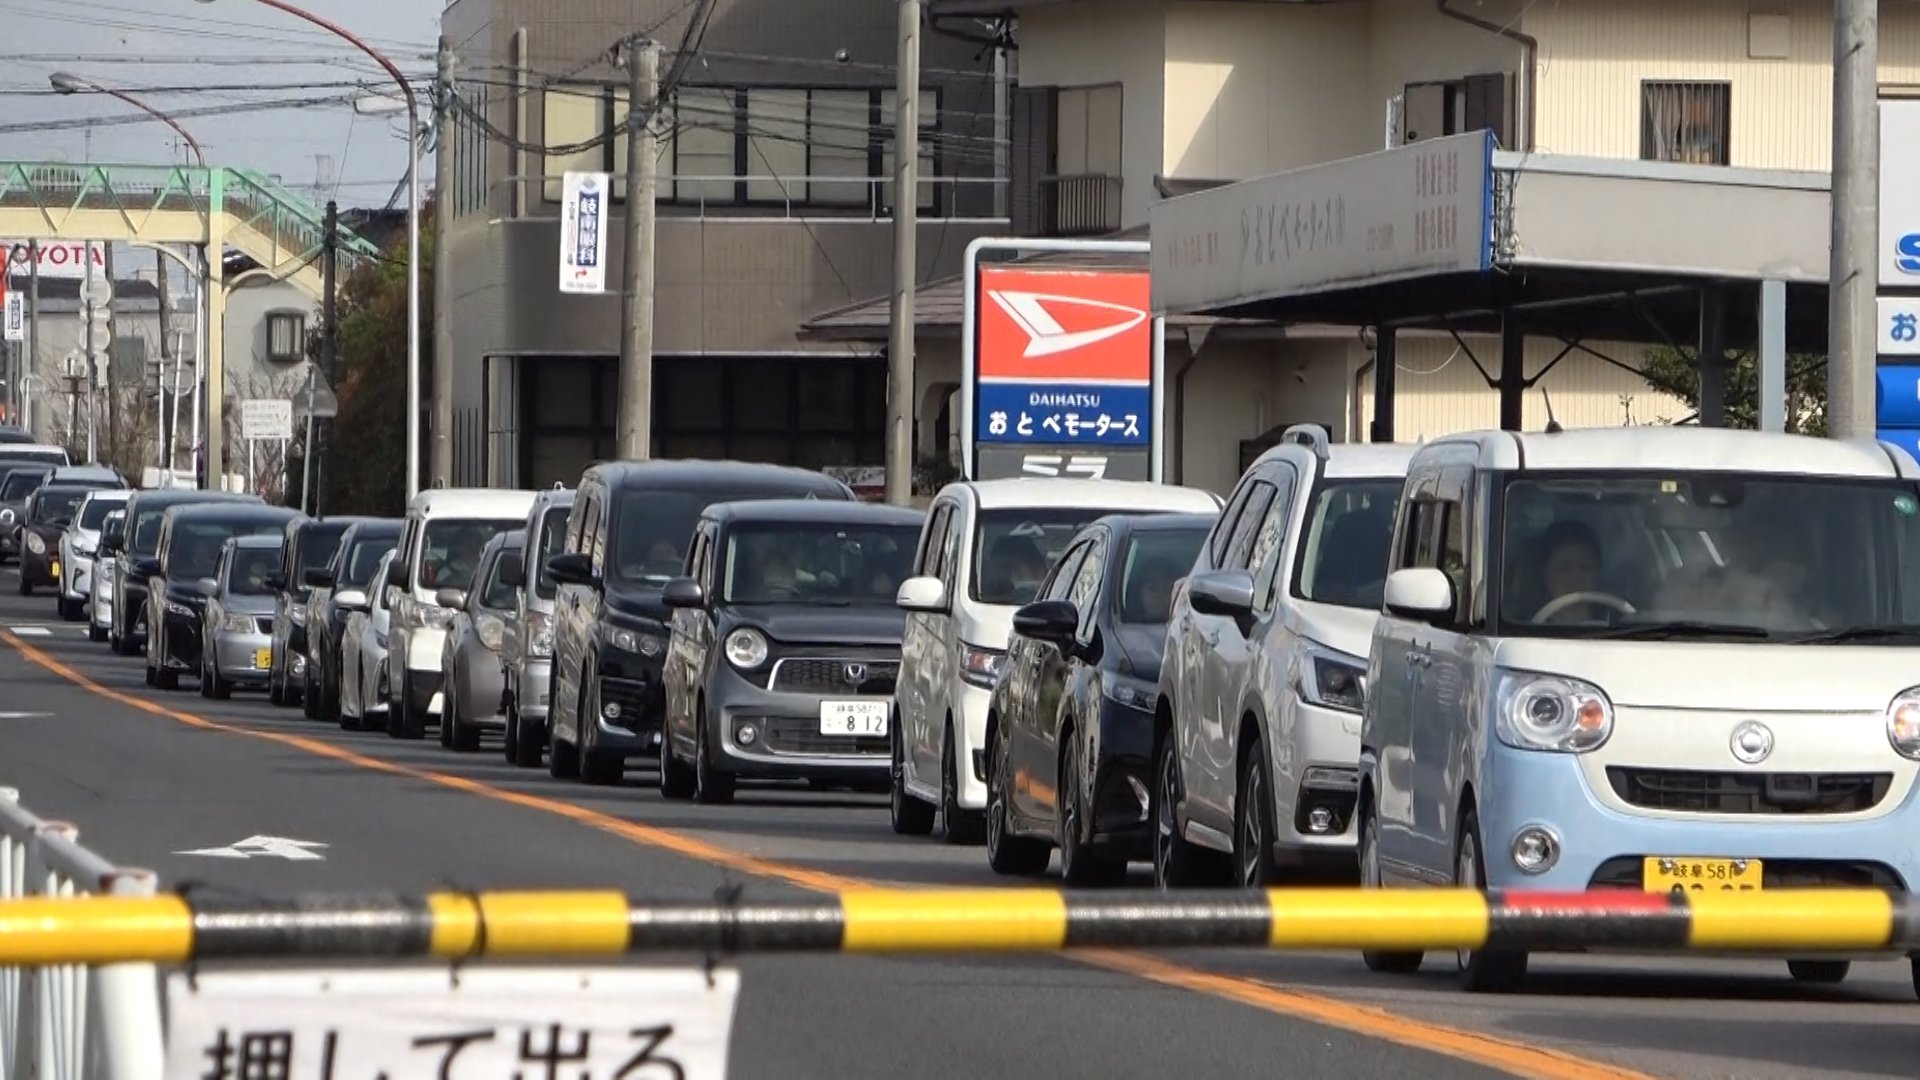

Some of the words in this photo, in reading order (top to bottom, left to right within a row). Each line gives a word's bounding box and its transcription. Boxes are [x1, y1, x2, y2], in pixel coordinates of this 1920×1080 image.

[1891, 313, 1917, 342] お
[1029, 392, 1100, 407] DAIHATSU
[988, 411, 1139, 436] おとべモータース
